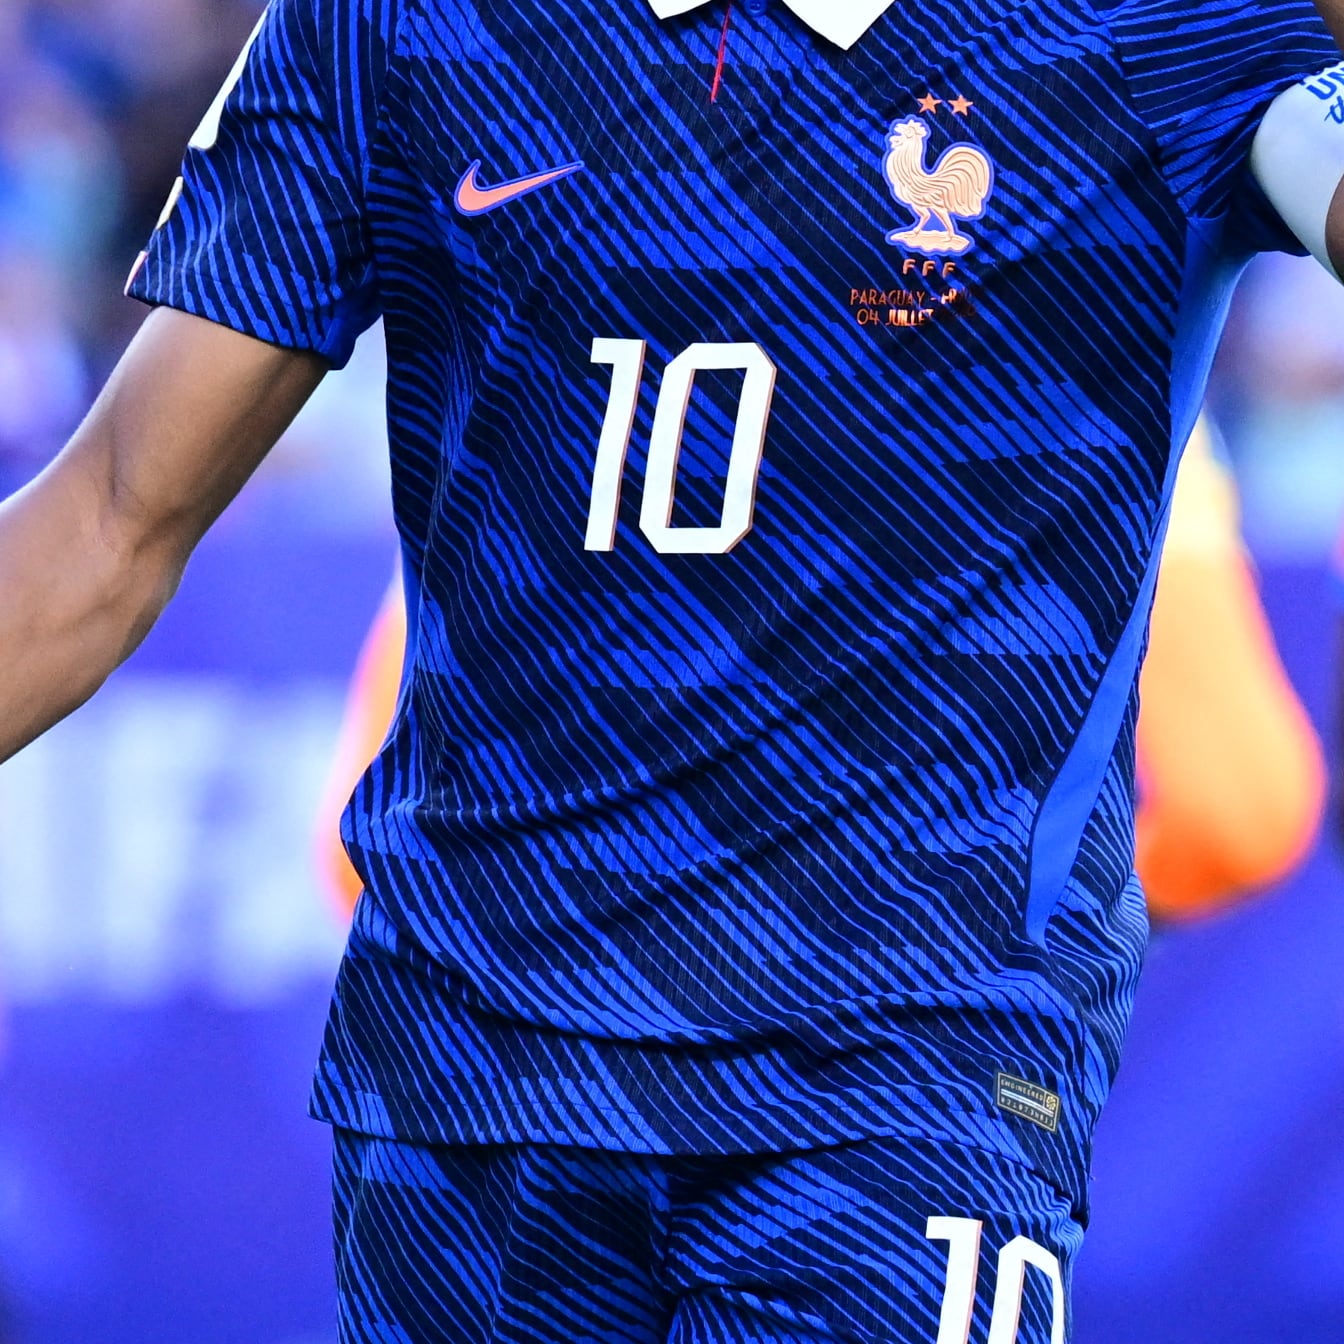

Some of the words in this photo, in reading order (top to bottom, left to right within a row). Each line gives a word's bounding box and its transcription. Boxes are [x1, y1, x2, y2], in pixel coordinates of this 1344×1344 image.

[850, 289, 925, 305] PARAGUAY
[857, 308, 879, 326] 04
[885, 308, 935, 326] JUILLET
[584, 337, 777, 554] 10
[925, 1215, 1064, 1344] 10
